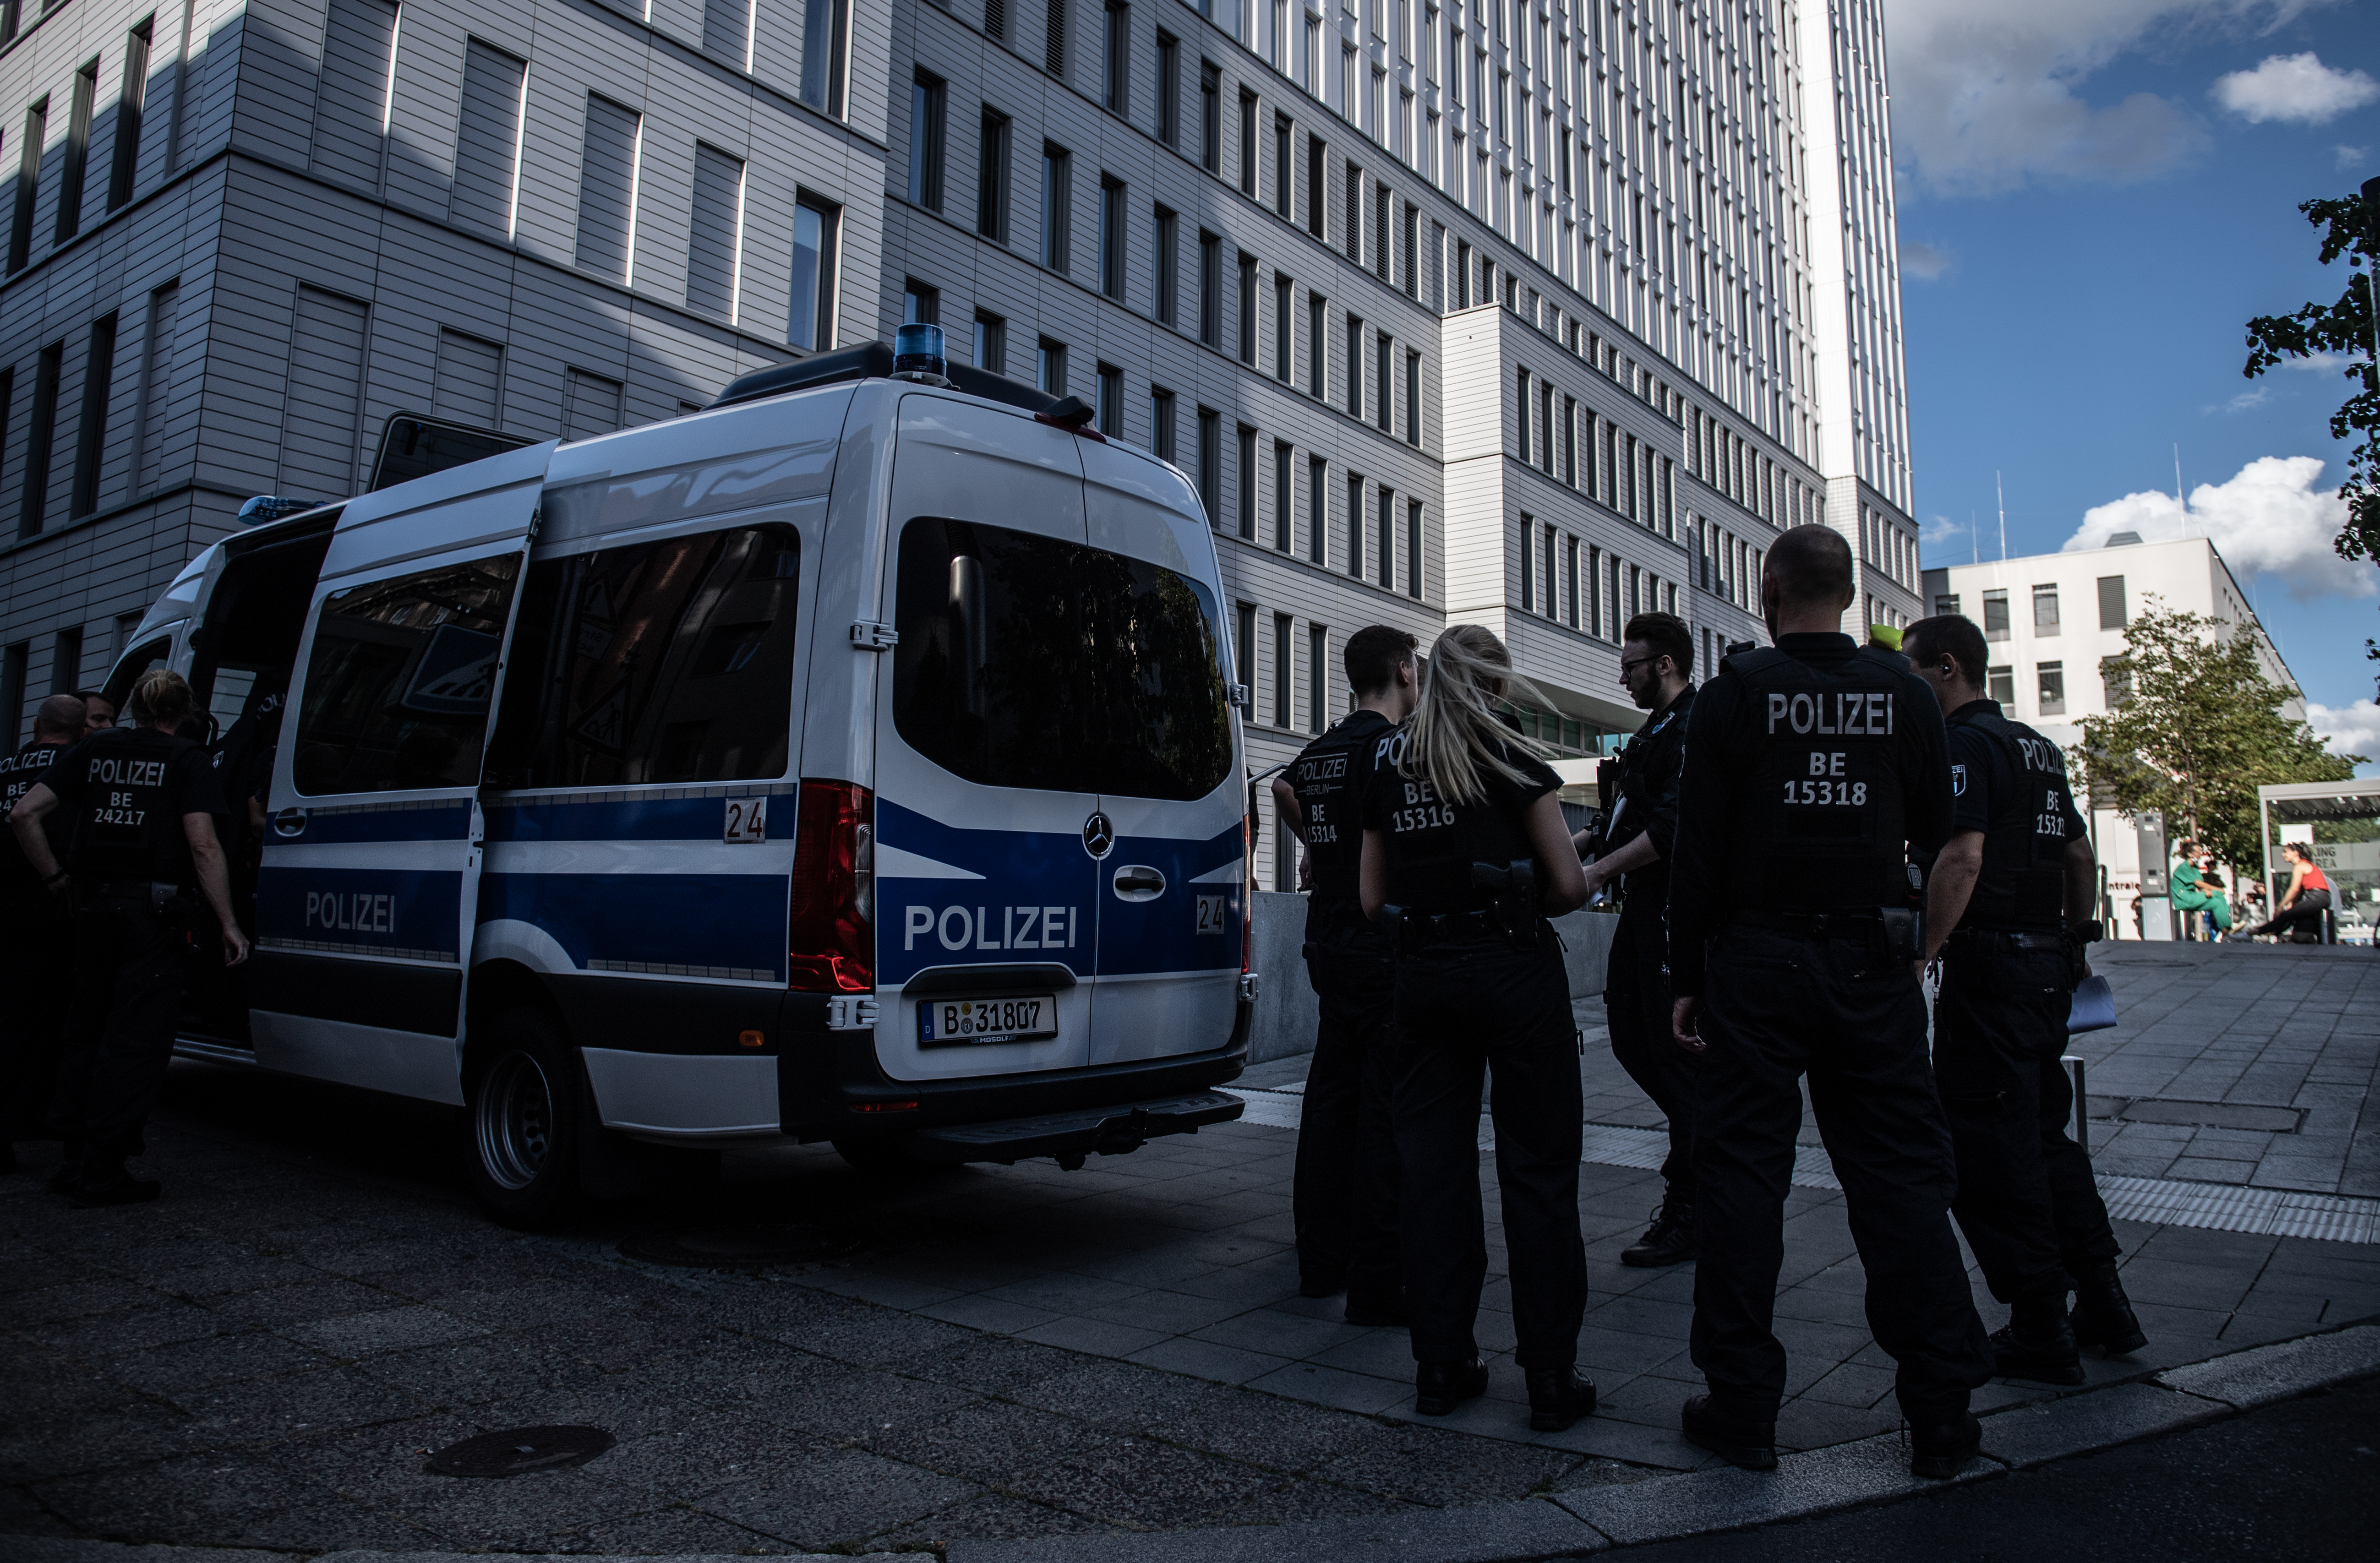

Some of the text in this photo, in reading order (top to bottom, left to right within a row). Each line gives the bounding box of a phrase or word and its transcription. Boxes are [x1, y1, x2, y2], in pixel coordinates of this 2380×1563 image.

[1769, 693, 1893, 735] POLIZEI
[0, 750, 56, 774] OLIZEI
[87, 758, 165, 786] POLIZEI
[1296, 758, 1347, 782] POLIZEI
[1809, 752, 1846, 776] BE
[7, 782, 27, 796] BE
[110, 792, 132, 807] BE
[1306, 784, 1329, 796] BERLIN
[1404, 780, 1433, 805] BE
[1784, 780, 1867, 806] 15318
[2047, 790, 2059, 811] BE
[94, 808, 145, 825] 24217
[727, 802, 762, 838] 24
[1312, 804, 1325, 822] BE
[1392, 803, 1455, 832] 15316
[306, 892, 395, 933] POLIZEI
[1199, 899, 1222, 929] 24
[905, 905, 1076, 951] POLIZEI
[925, 1025, 930, 1034] D
[944, 1001, 1040, 1035] B 31807
[980, 1035, 1010, 1044] MOSOLF
